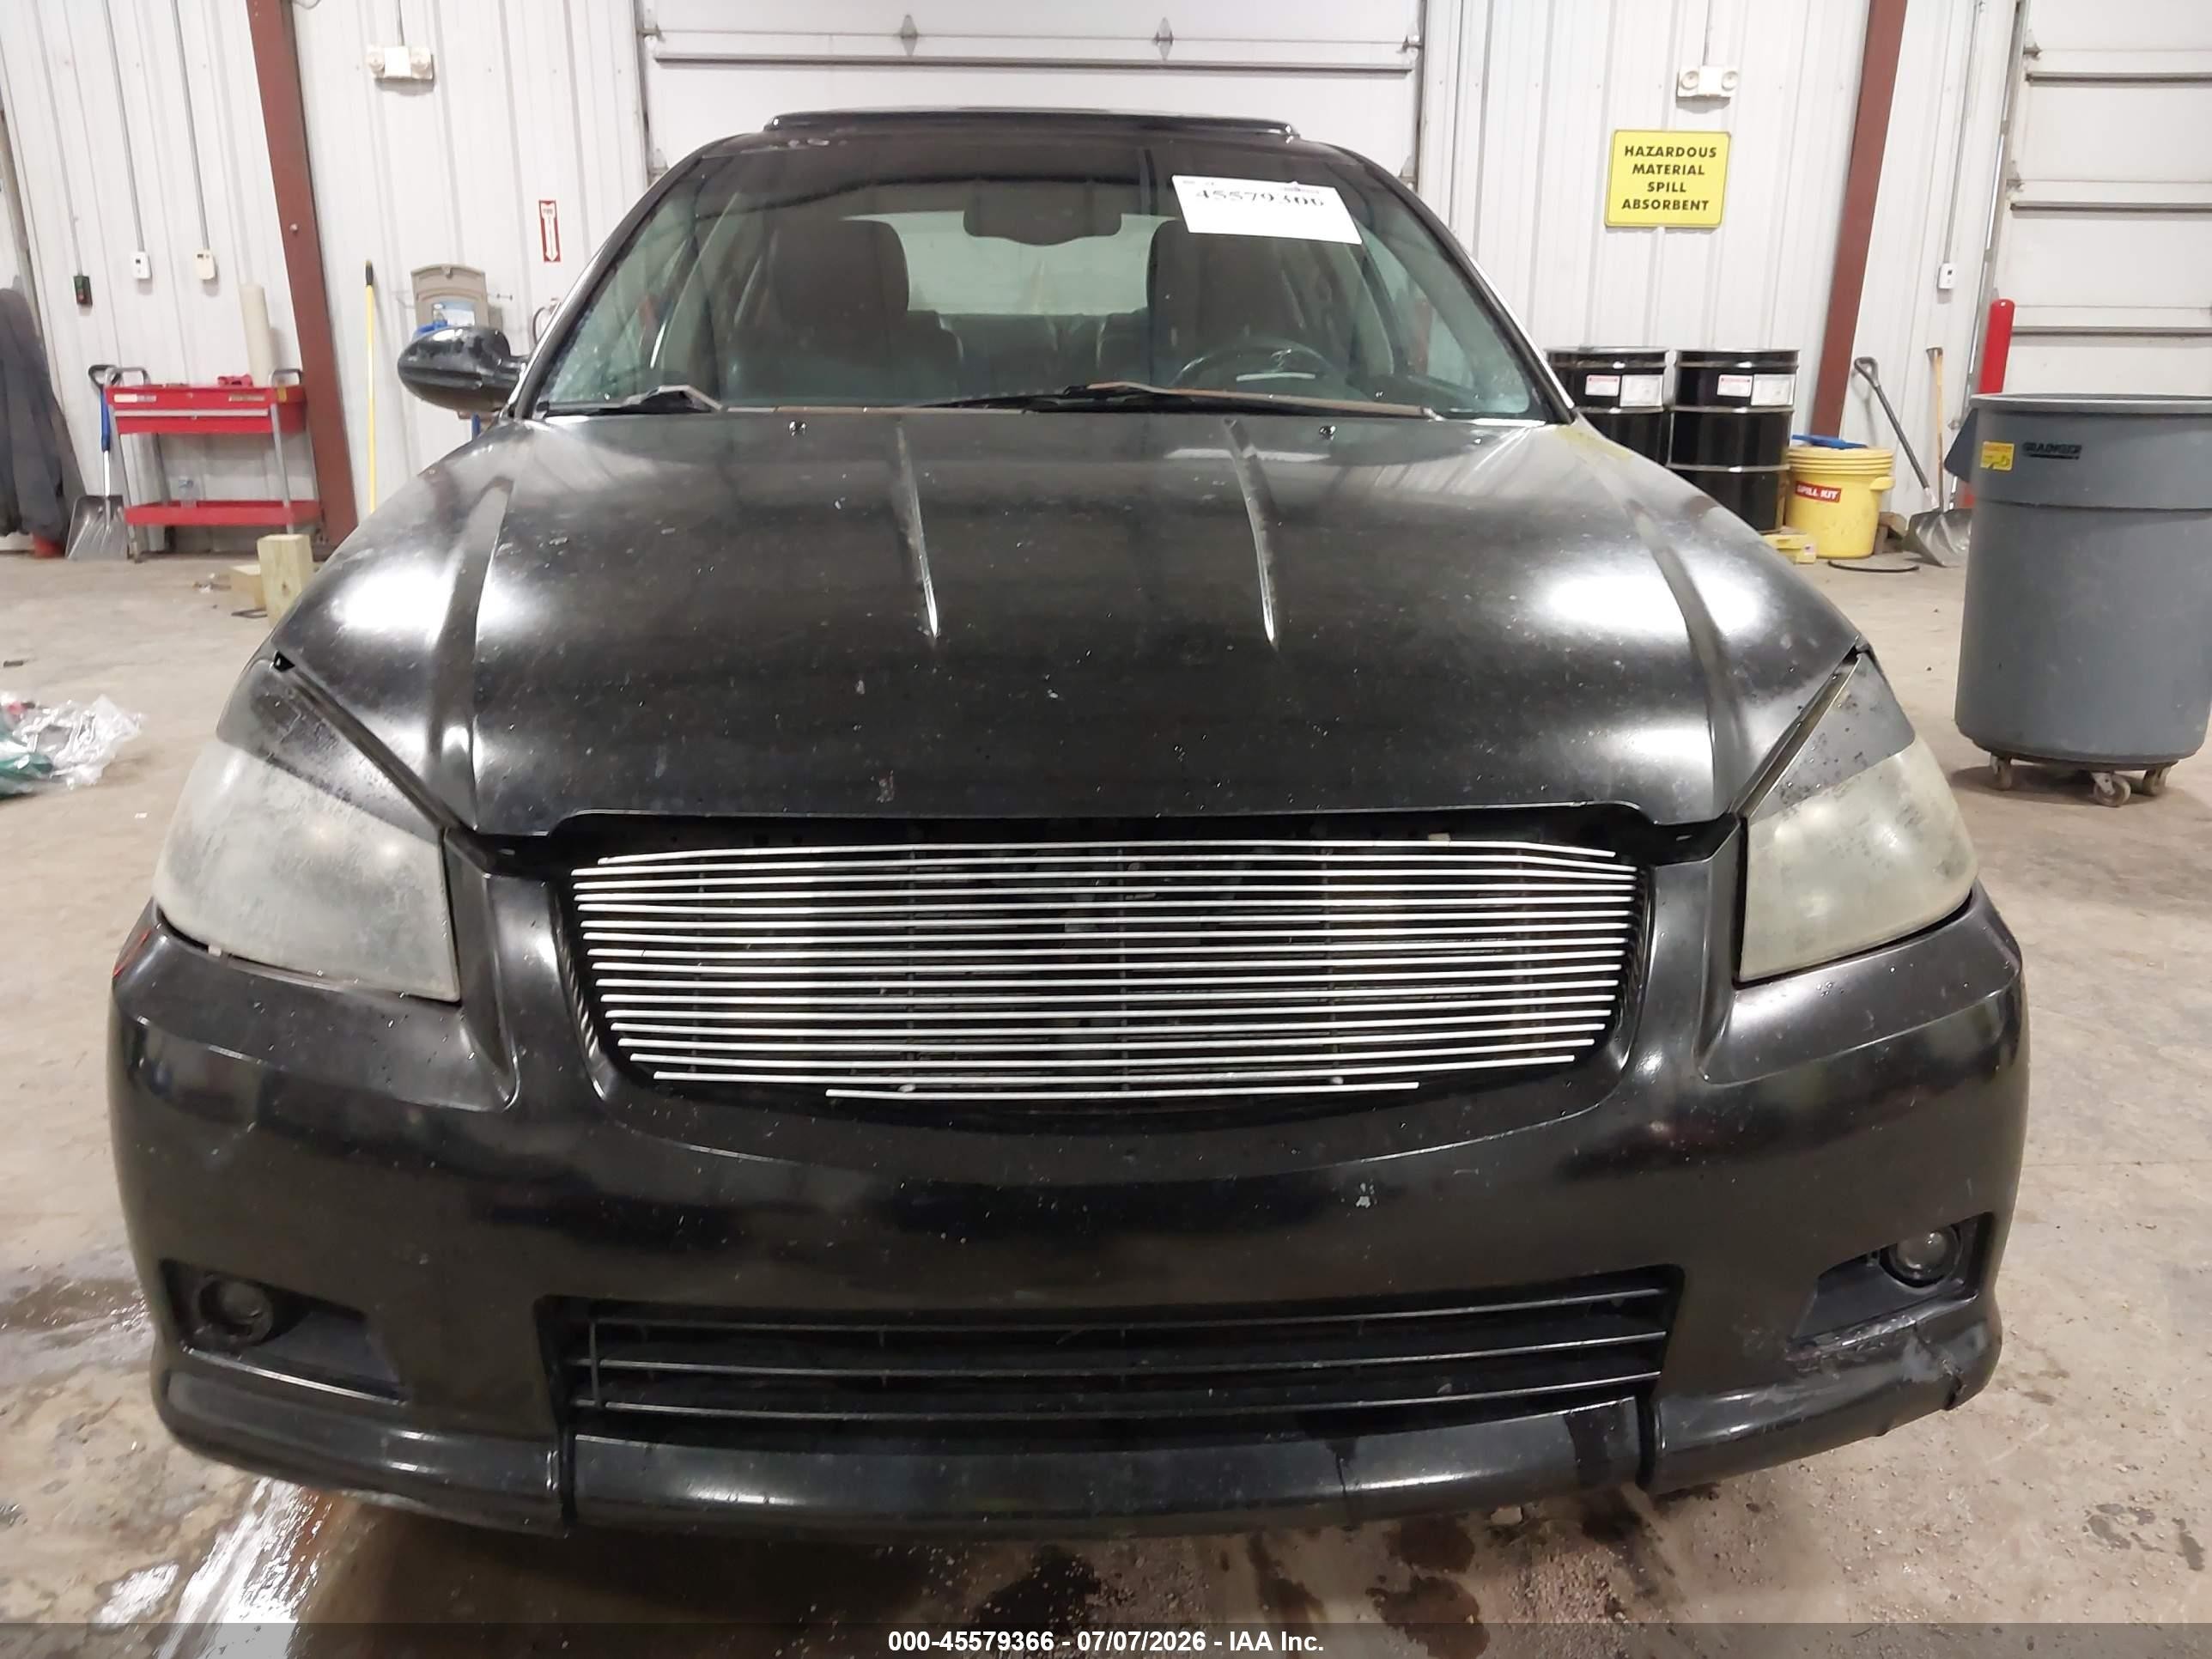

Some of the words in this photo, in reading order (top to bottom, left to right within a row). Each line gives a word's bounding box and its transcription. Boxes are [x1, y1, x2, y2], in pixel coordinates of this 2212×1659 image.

[1624, 145, 1717, 158] HAZARDOUS
[1632, 163, 1705, 175] MATERIAL
[1646, 181, 1687, 193] SPILL
[1621, 198, 1710, 211] ABSORBENT
[1796, 483, 1820, 497] SPILL
[1820, 489, 1839, 500] KIT
